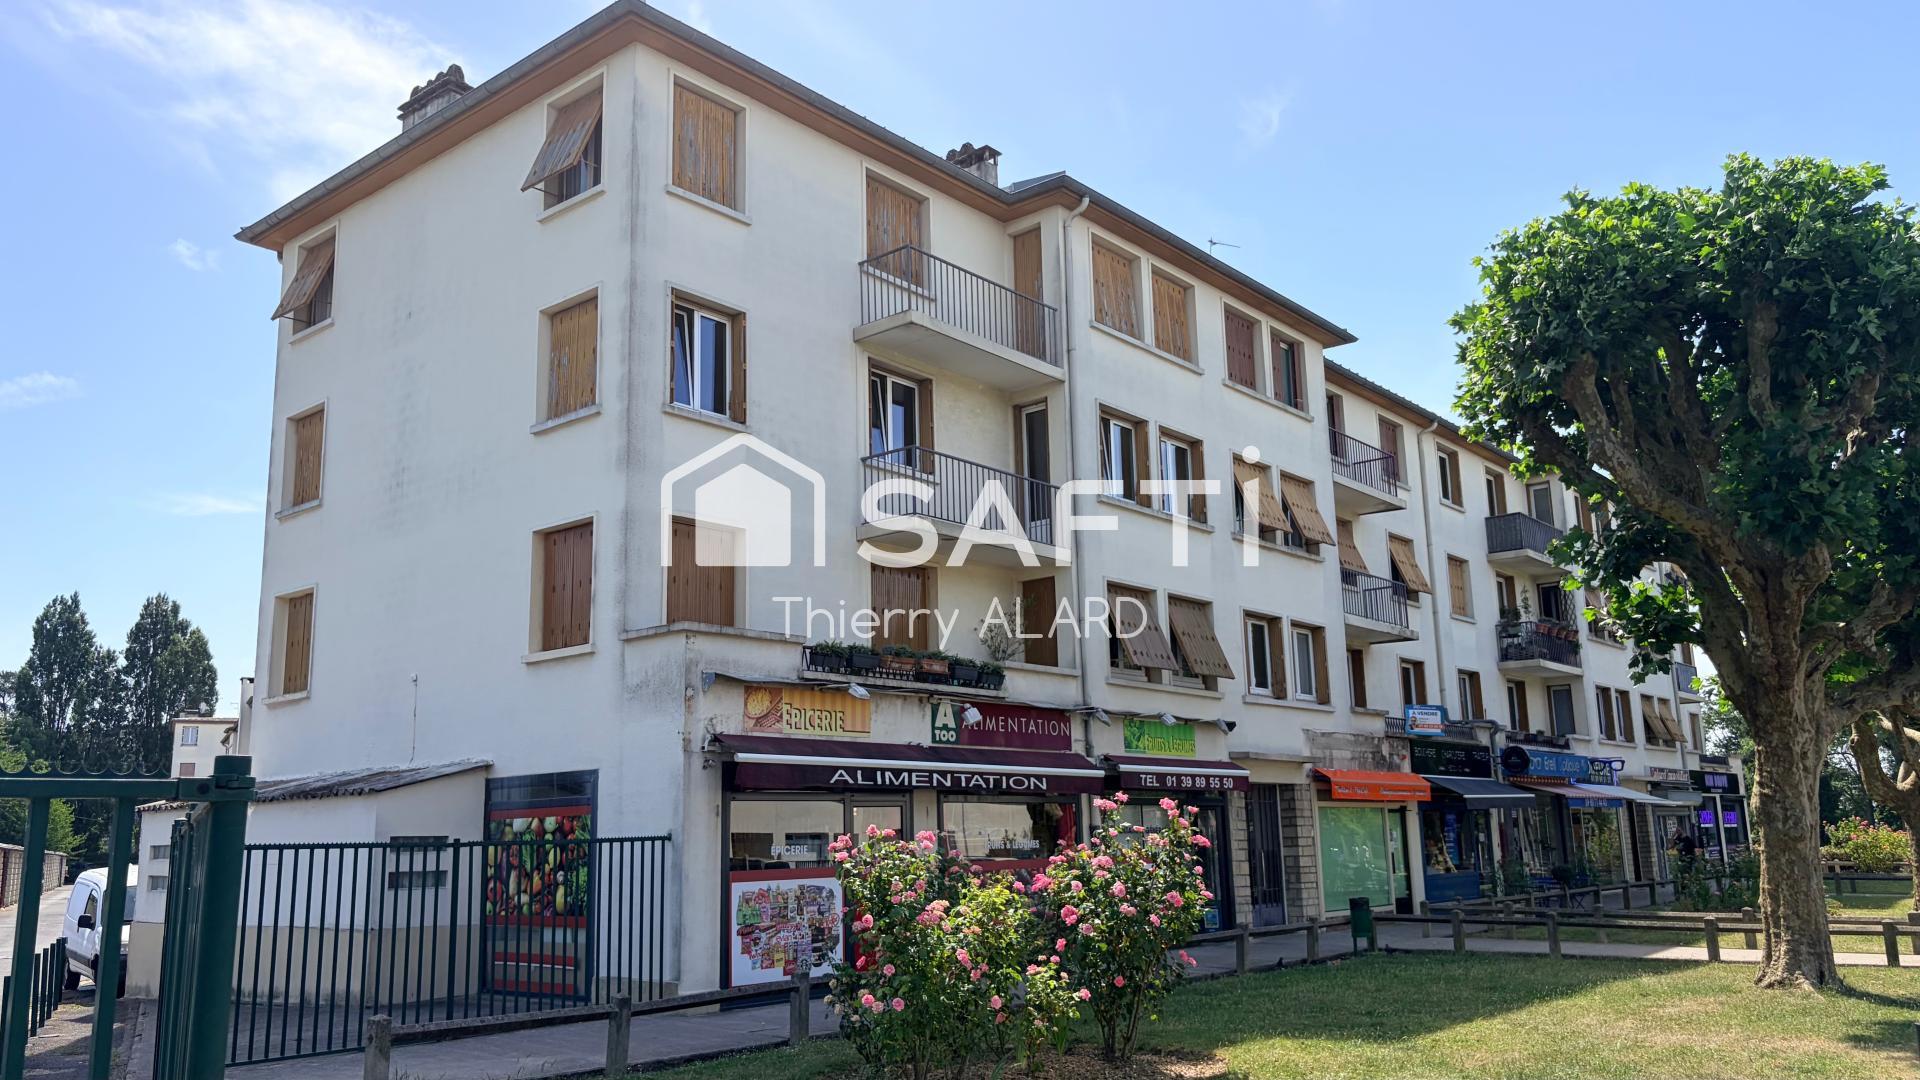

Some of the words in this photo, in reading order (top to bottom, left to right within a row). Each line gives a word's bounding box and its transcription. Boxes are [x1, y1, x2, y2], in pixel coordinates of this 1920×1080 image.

[783, 703, 845, 732] EPICERIE
[934, 699, 957, 728] A
[934, 730, 957, 742] TOO
[829, 769, 1048, 791] ALIMENTATION
[1140, 774, 1160, 787] TEL
[1166, 776, 1177, 787] 01
[1181, 776, 1192, 787] 39
[1195, 777, 1206, 788] 89
[1209, 777, 1220, 788] 55
[1223, 778, 1234, 789] 50
